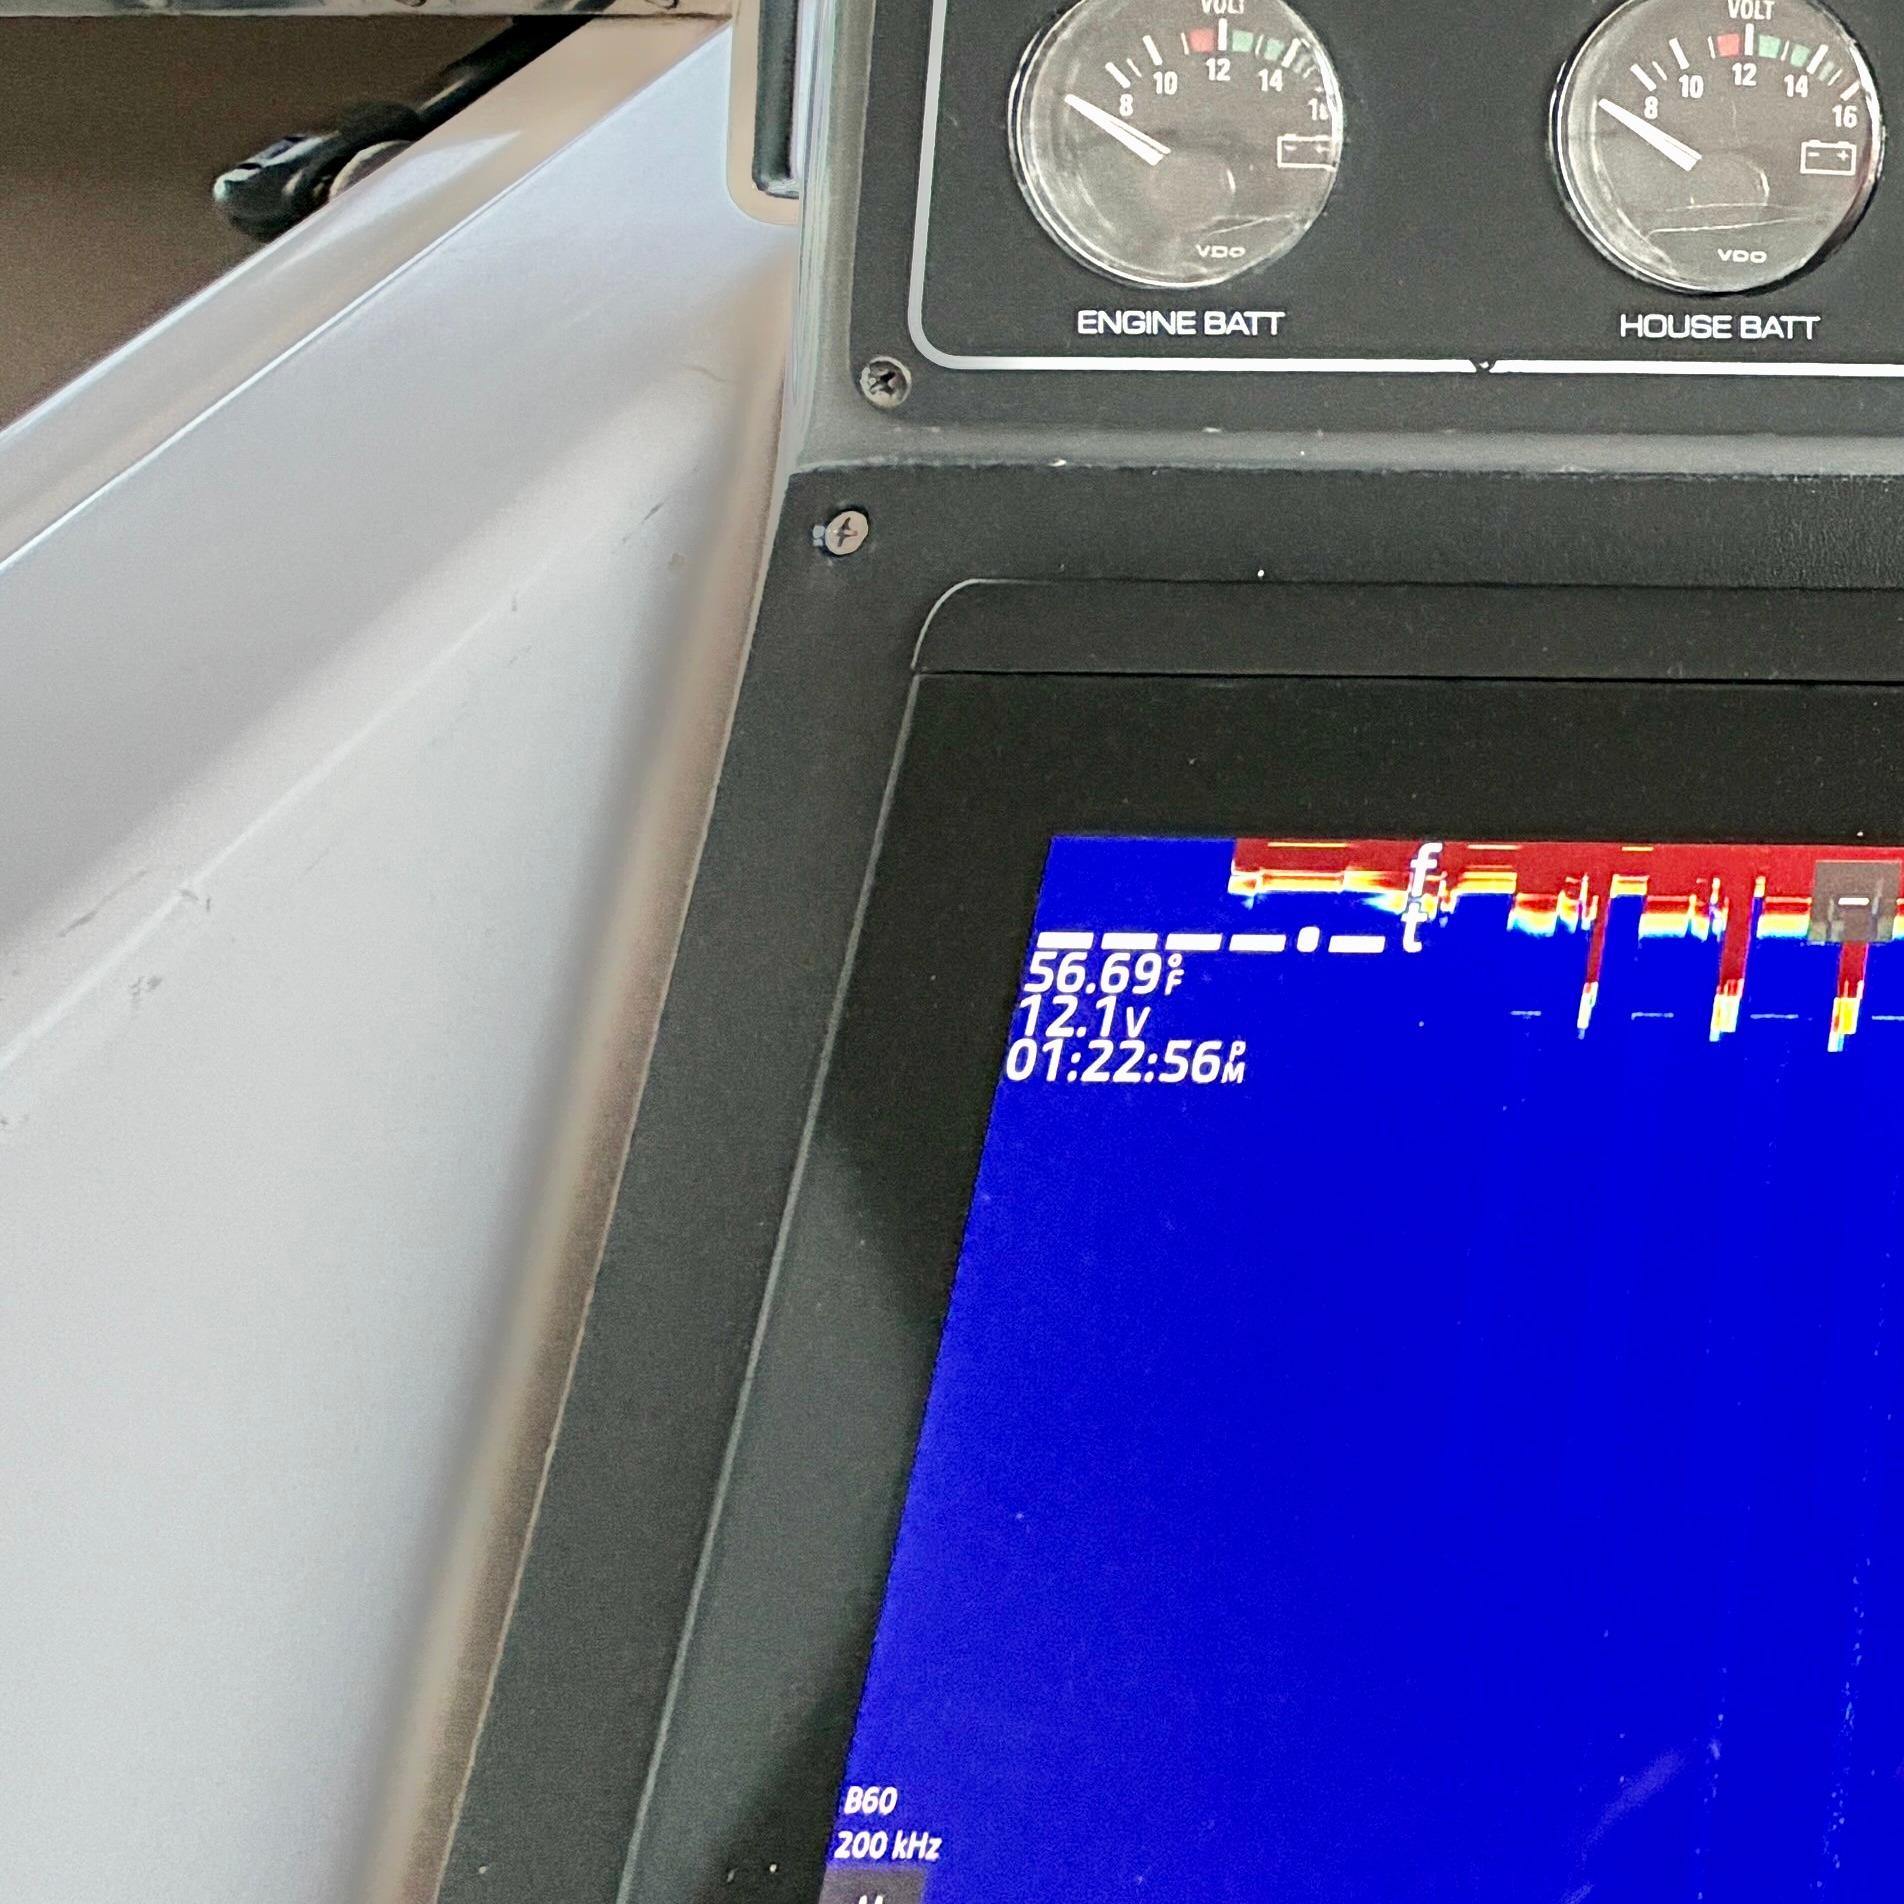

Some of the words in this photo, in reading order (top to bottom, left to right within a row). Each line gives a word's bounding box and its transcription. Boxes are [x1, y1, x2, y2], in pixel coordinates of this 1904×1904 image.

[1206, 57, 1231, 81] 12
[1258, 68, 1284, 93] 14
[1731, 62, 1758, 86] 12
[1153, 71, 1178, 95] 10
[1678, 74, 1704, 99] 10
[1783, 74, 1809, 98] 14
[1119, 94, 1134, 117] 8
[1643, 97, 1659, 119] 8
[1832, 105, 1857, 129] 16
[1195, 243, 1246, 259] VDO
[1717, 248, 1767, 264] VDO
[1077, 309, 1197, 335] ENGINE
[1203, 310, 1286, 336] BATT
[1620, 313, 1732, 339] HOUSE
[1740, 315, 1821, 340] BATT
[844, 1786, 898, 1815] B60
[834, 1831, 888, 1860] 200
[892, 1829, 942, 1861] kHz
